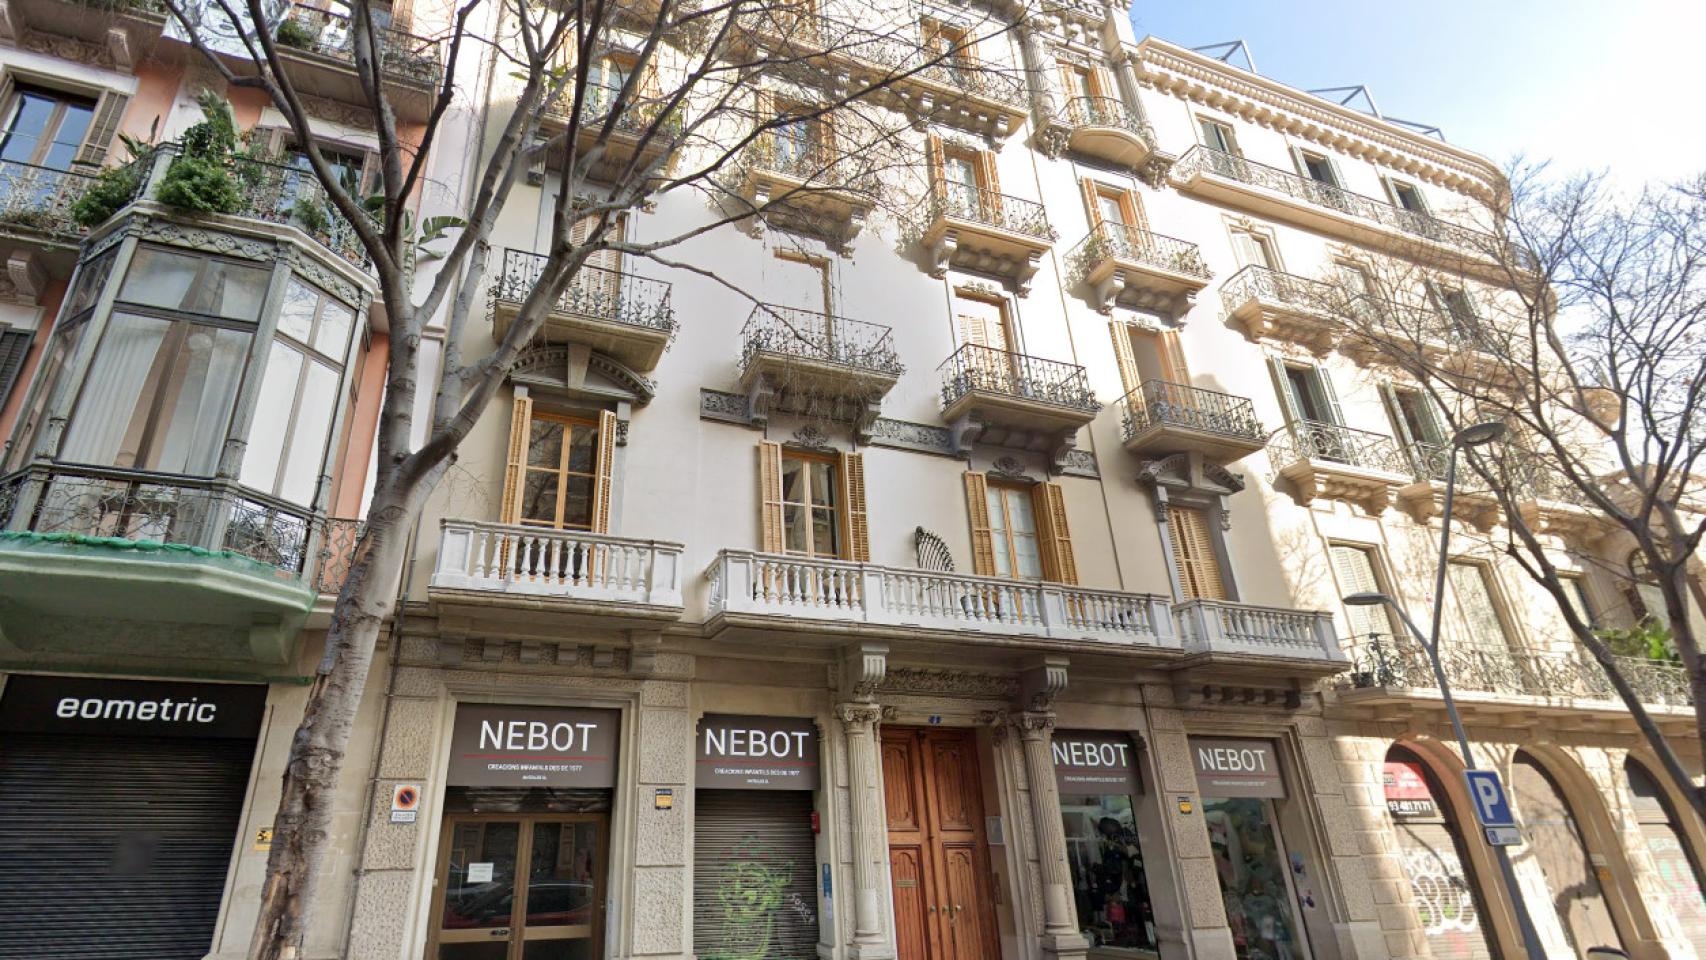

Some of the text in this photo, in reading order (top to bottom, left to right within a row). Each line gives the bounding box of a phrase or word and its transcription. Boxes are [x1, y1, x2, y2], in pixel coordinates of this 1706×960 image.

[56, 696, 216, 723] eometric
[479, 720, 597, 752] NEBOT
[704, 728, 809, 759] NEBOT
[1051, 742, 1128, 768] NEBOT
[1199, 747, 1266, 772] NEBOT
[1474, 777, 1498, 819] P
